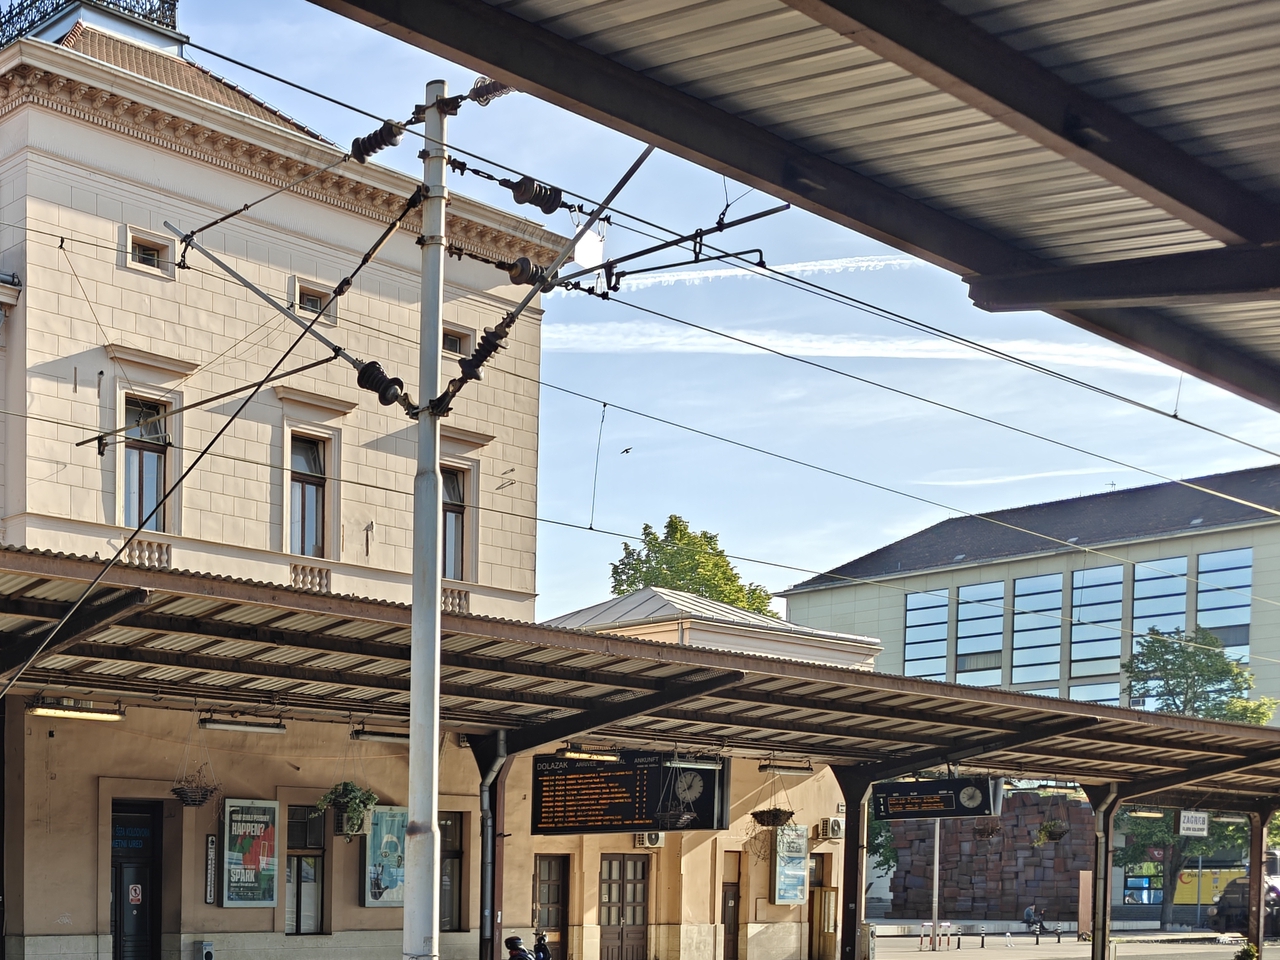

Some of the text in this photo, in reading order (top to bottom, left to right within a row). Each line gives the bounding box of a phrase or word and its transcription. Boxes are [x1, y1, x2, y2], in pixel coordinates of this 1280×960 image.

[537, 761, 568, 770] DOLAZAK
[1183, 815, 1205, 825] ZAGREB
[231, 822, 265, 836] HAPPEN?
[230, 869, 256, 882] SPARK
